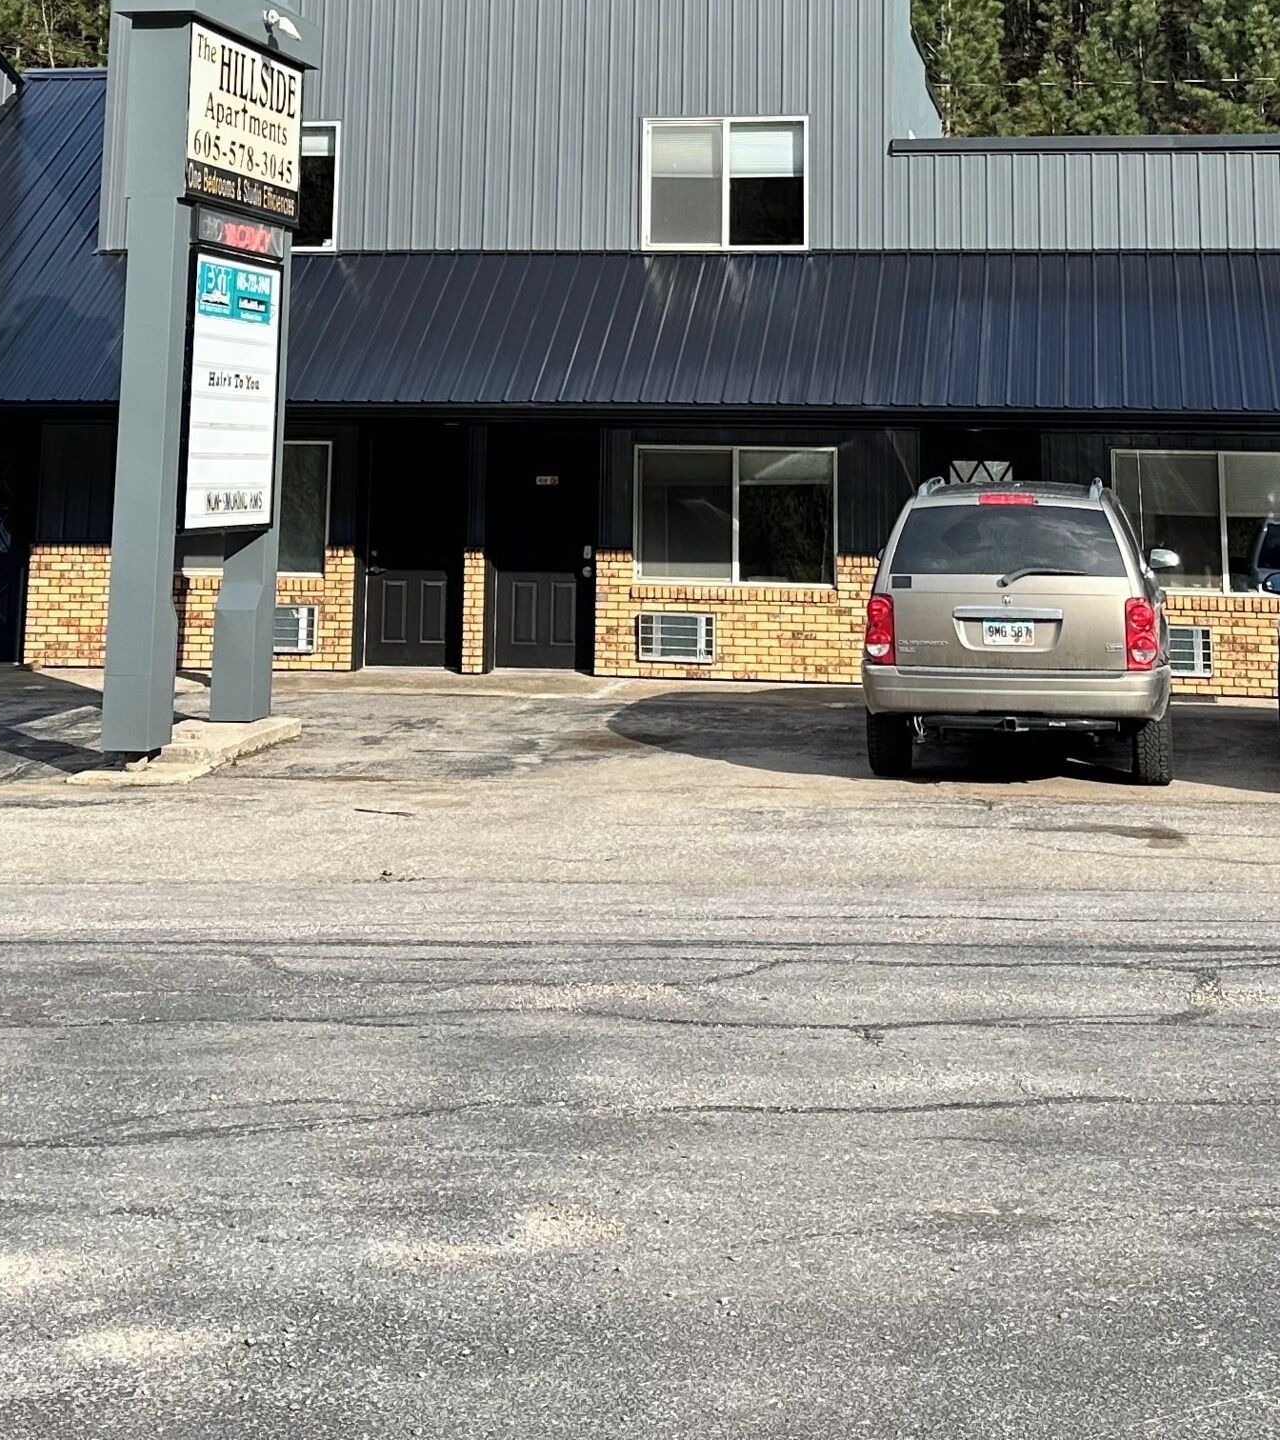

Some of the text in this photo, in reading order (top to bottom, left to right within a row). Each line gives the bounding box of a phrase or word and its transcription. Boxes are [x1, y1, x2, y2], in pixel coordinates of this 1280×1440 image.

[198, 33, 296, 120] The HILLSIDE
[205, 91, 288, 146] Apartments
[194, 129, 293, 184] 605-578-3045
[188, 162, 201, 190] One
[203, 167, 235, 199] Bedrooms
[208, 370, 260, 390] Hair's To You
[988, 625, 1030, 638] 9MG 587
